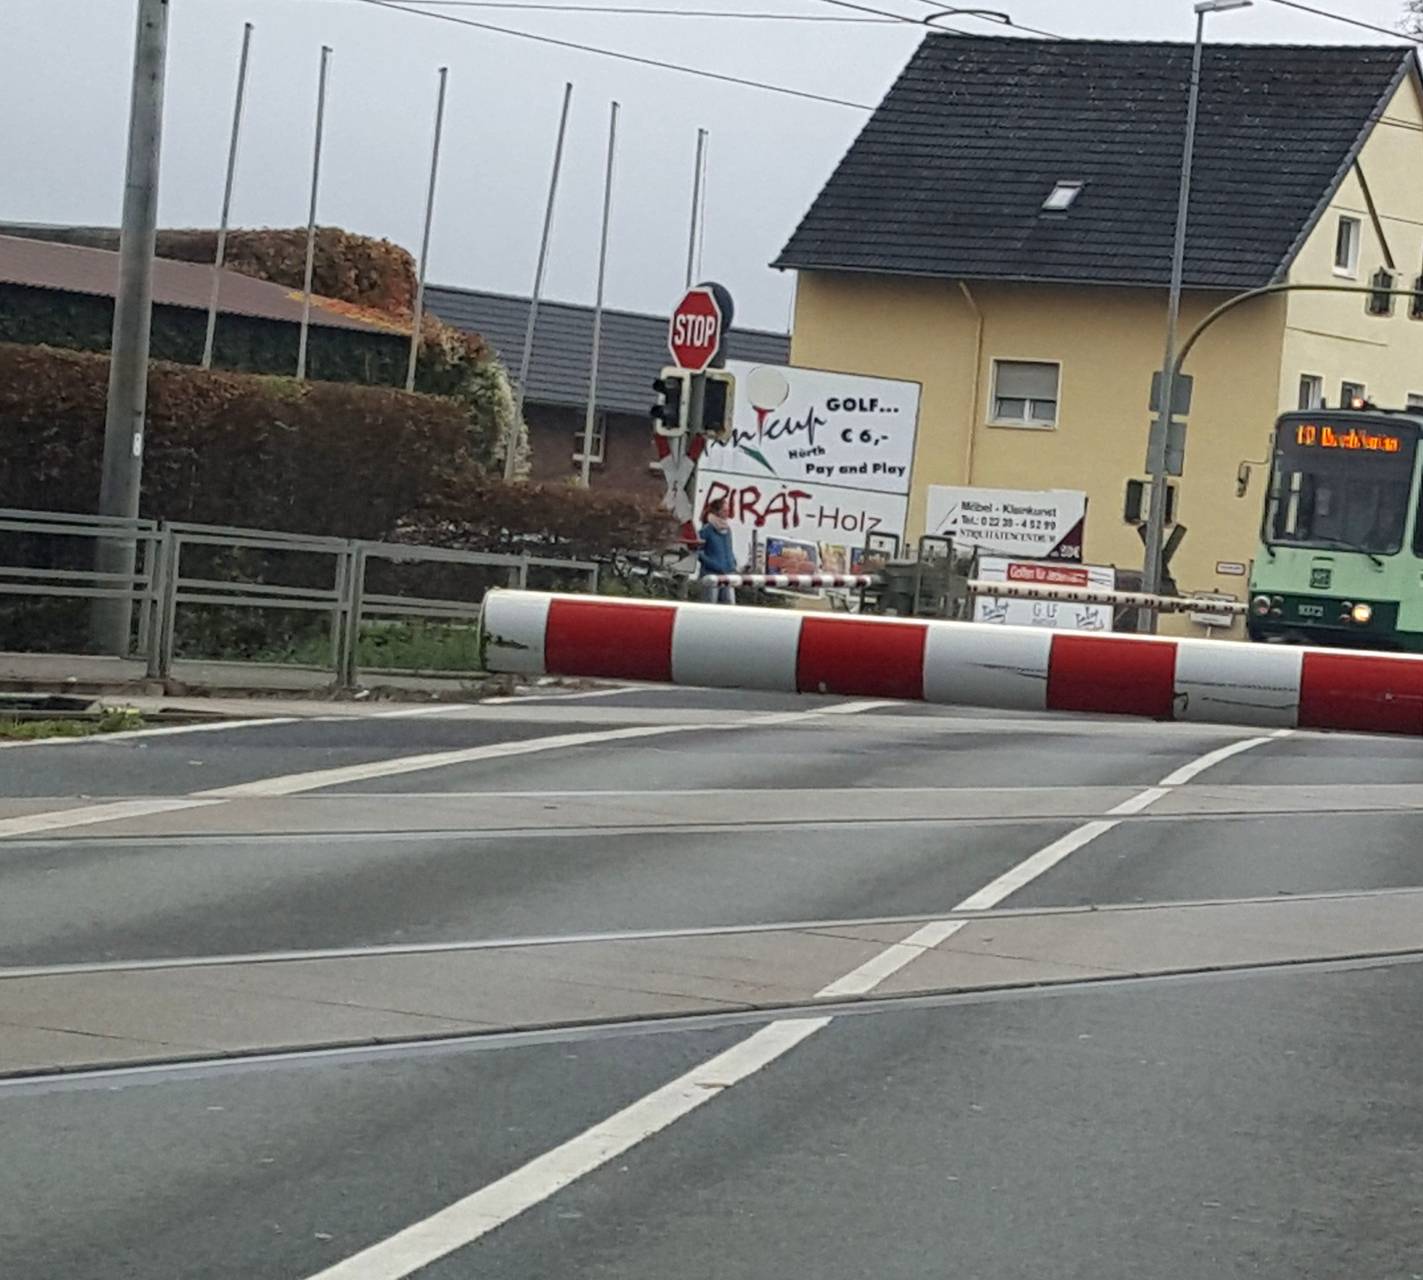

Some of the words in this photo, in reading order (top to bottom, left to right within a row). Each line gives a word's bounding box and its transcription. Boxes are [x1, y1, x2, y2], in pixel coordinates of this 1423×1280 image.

[674, 314, 716, 347] STOP
[826, 398, 899, 413] GOLF...
[806, 463, 835, 479] Pay
[839, 462, 868, 475] and
[873, 463, 906, 478] Play
